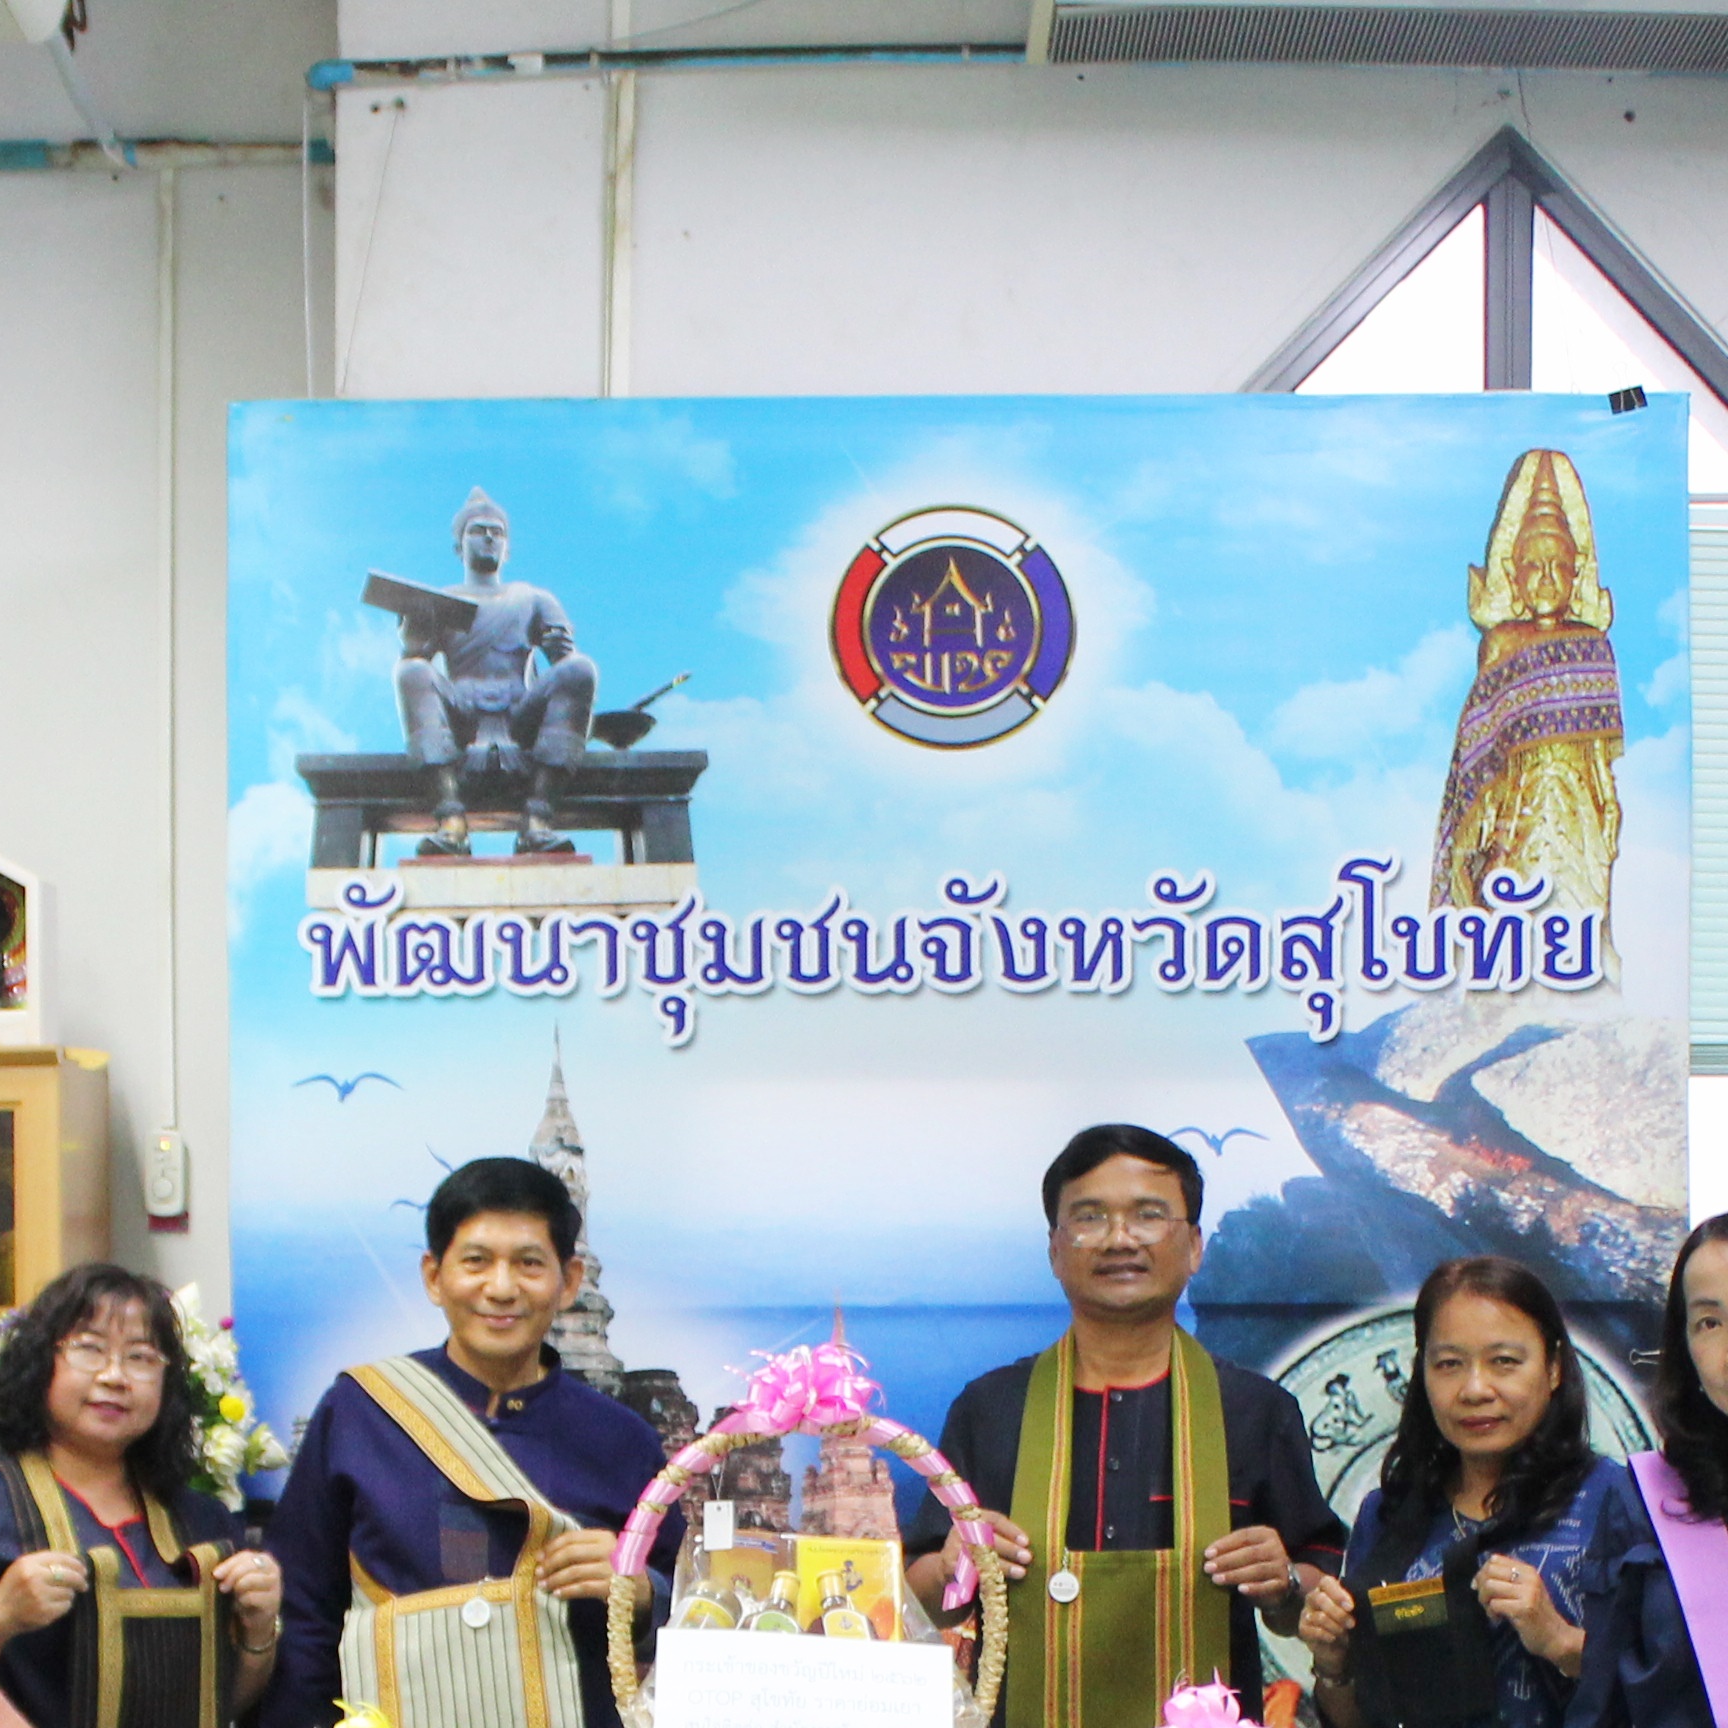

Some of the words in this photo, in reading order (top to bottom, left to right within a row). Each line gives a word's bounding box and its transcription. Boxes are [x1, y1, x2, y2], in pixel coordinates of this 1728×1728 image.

[305, 857, 1600, 1038] พัฒนาชุมชนจังหวัดสุโขทัย
[681, 1654, 866, 1684] กระเช้าของขวัญปีใหม่
[687, 1689, 743, 1707] OTOP
[749, 1687, 808, 1713] สุโขทัย
[813, 1693, 923, 1716] ราคาย่อมเยา
